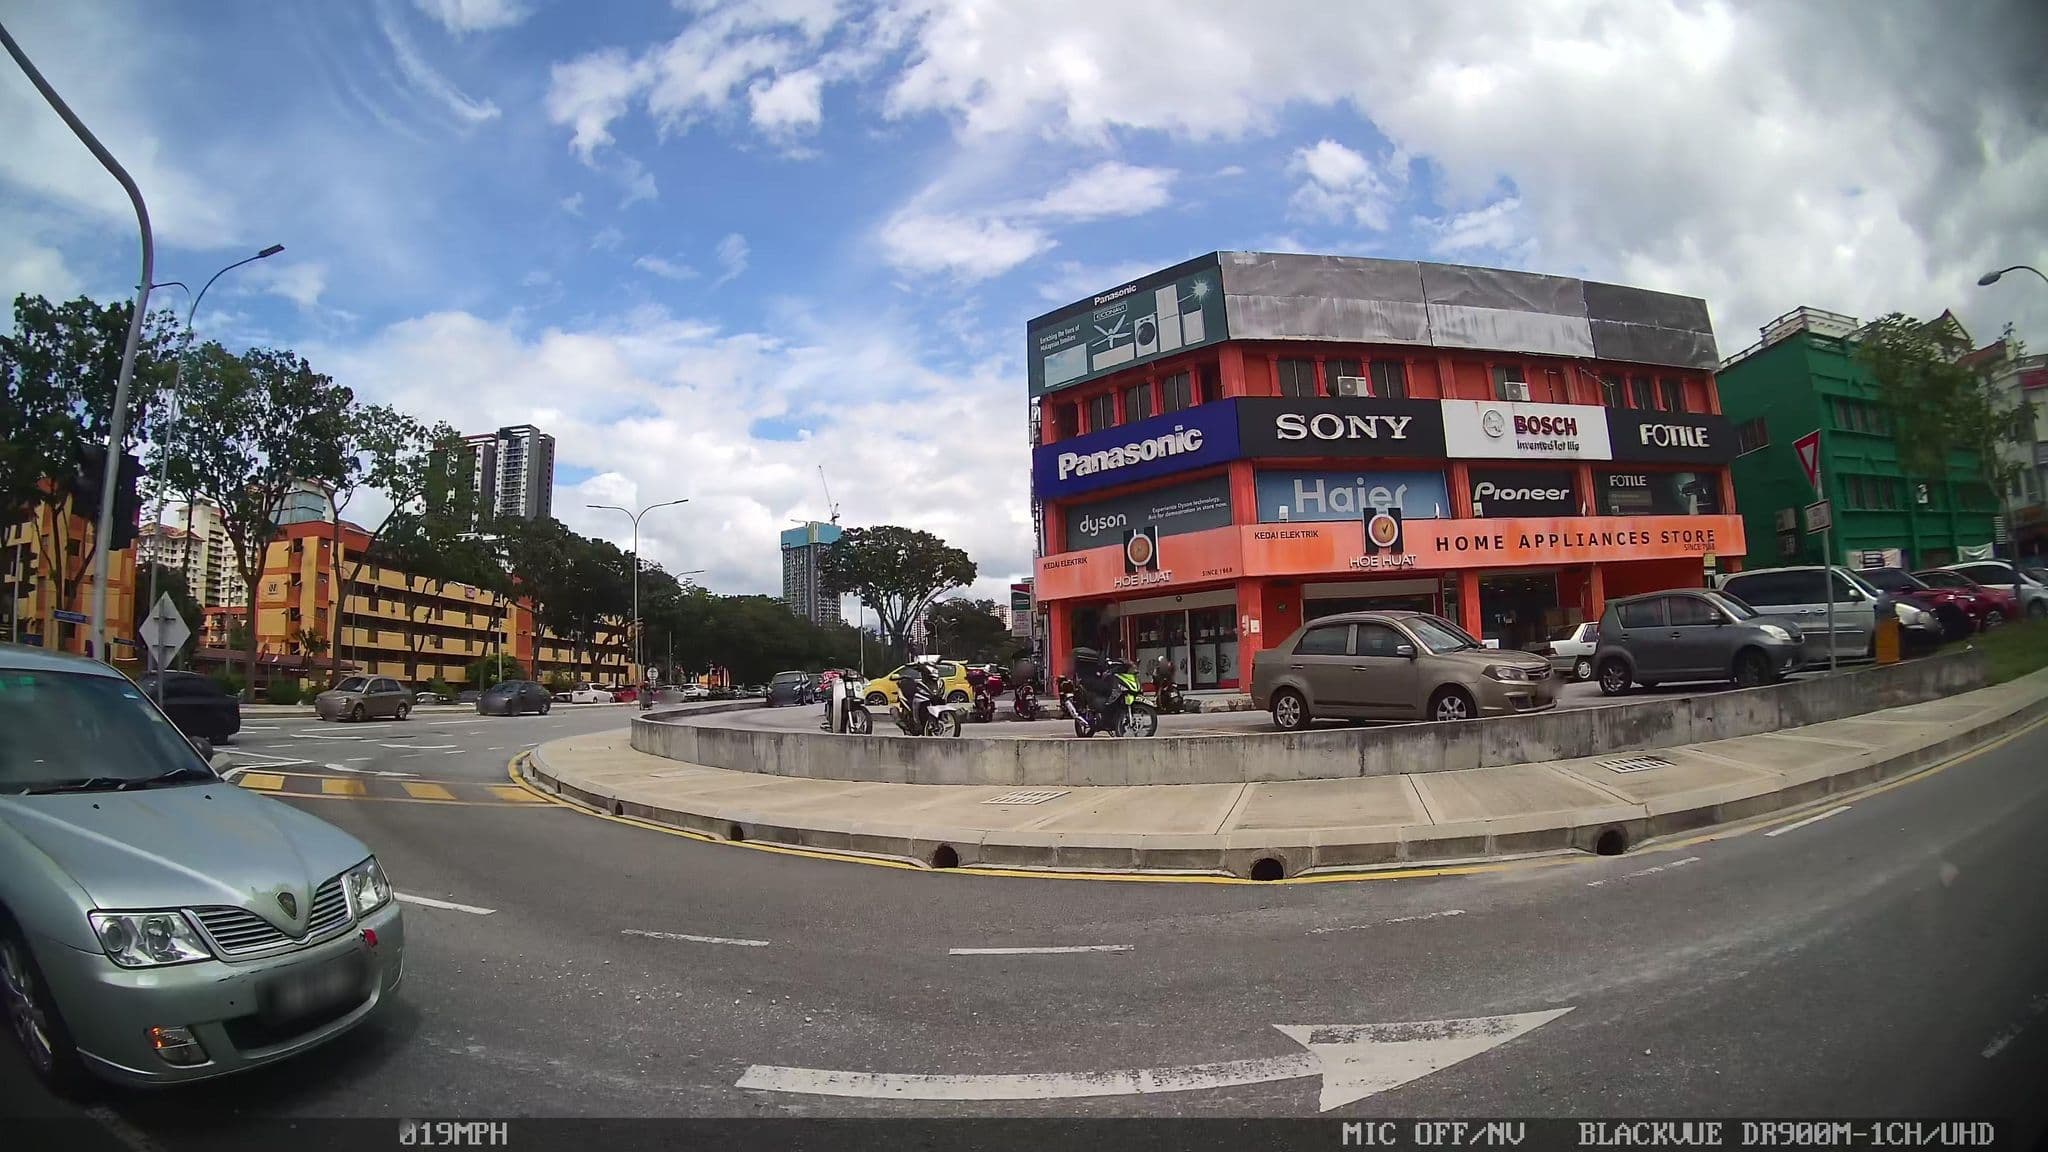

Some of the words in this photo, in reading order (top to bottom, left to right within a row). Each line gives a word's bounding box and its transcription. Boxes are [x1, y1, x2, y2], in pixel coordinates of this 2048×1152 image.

[1094, 284, 1137, 306] Panasonic
[1275, 413, 1412, 440] SONY
[1513, 415, 1578, 436] BOSCH
[1639, 423, 1711, 448] FOTILE
[1058, 425, 1203, 480] Panasonic
[1609, 474, 1647, 487] FOTILE
[1294, 476, 1408, 513] Haier
[1474, 481, 1570, 502] Pioneer
[1079, 513, 1127, 537] dyson
[1254, 531, 1279, 540] KEDAI
[1280, 530, 1319, 539] ELEKTRIK
[1436, 535, 1504, 552] HOME
[1518, 531, 1650, 549] APPLIANCES
[1661, 530, 1715, 544] STORE
[1684, 543, 1702, 551] SINCE
[1043, 561, 1060, 570] KEDAI
[1060, 557, 1088, 568] ELEKTRIK
[1350, 555, 1378, 568] HOE
[1382, 554, 1417, 567] HUAT
[1114, 574, 1140, 588] HOE
[1140, 570, 1173, 584] HUAT
[1202, 569, 1218, 577] SINCE
